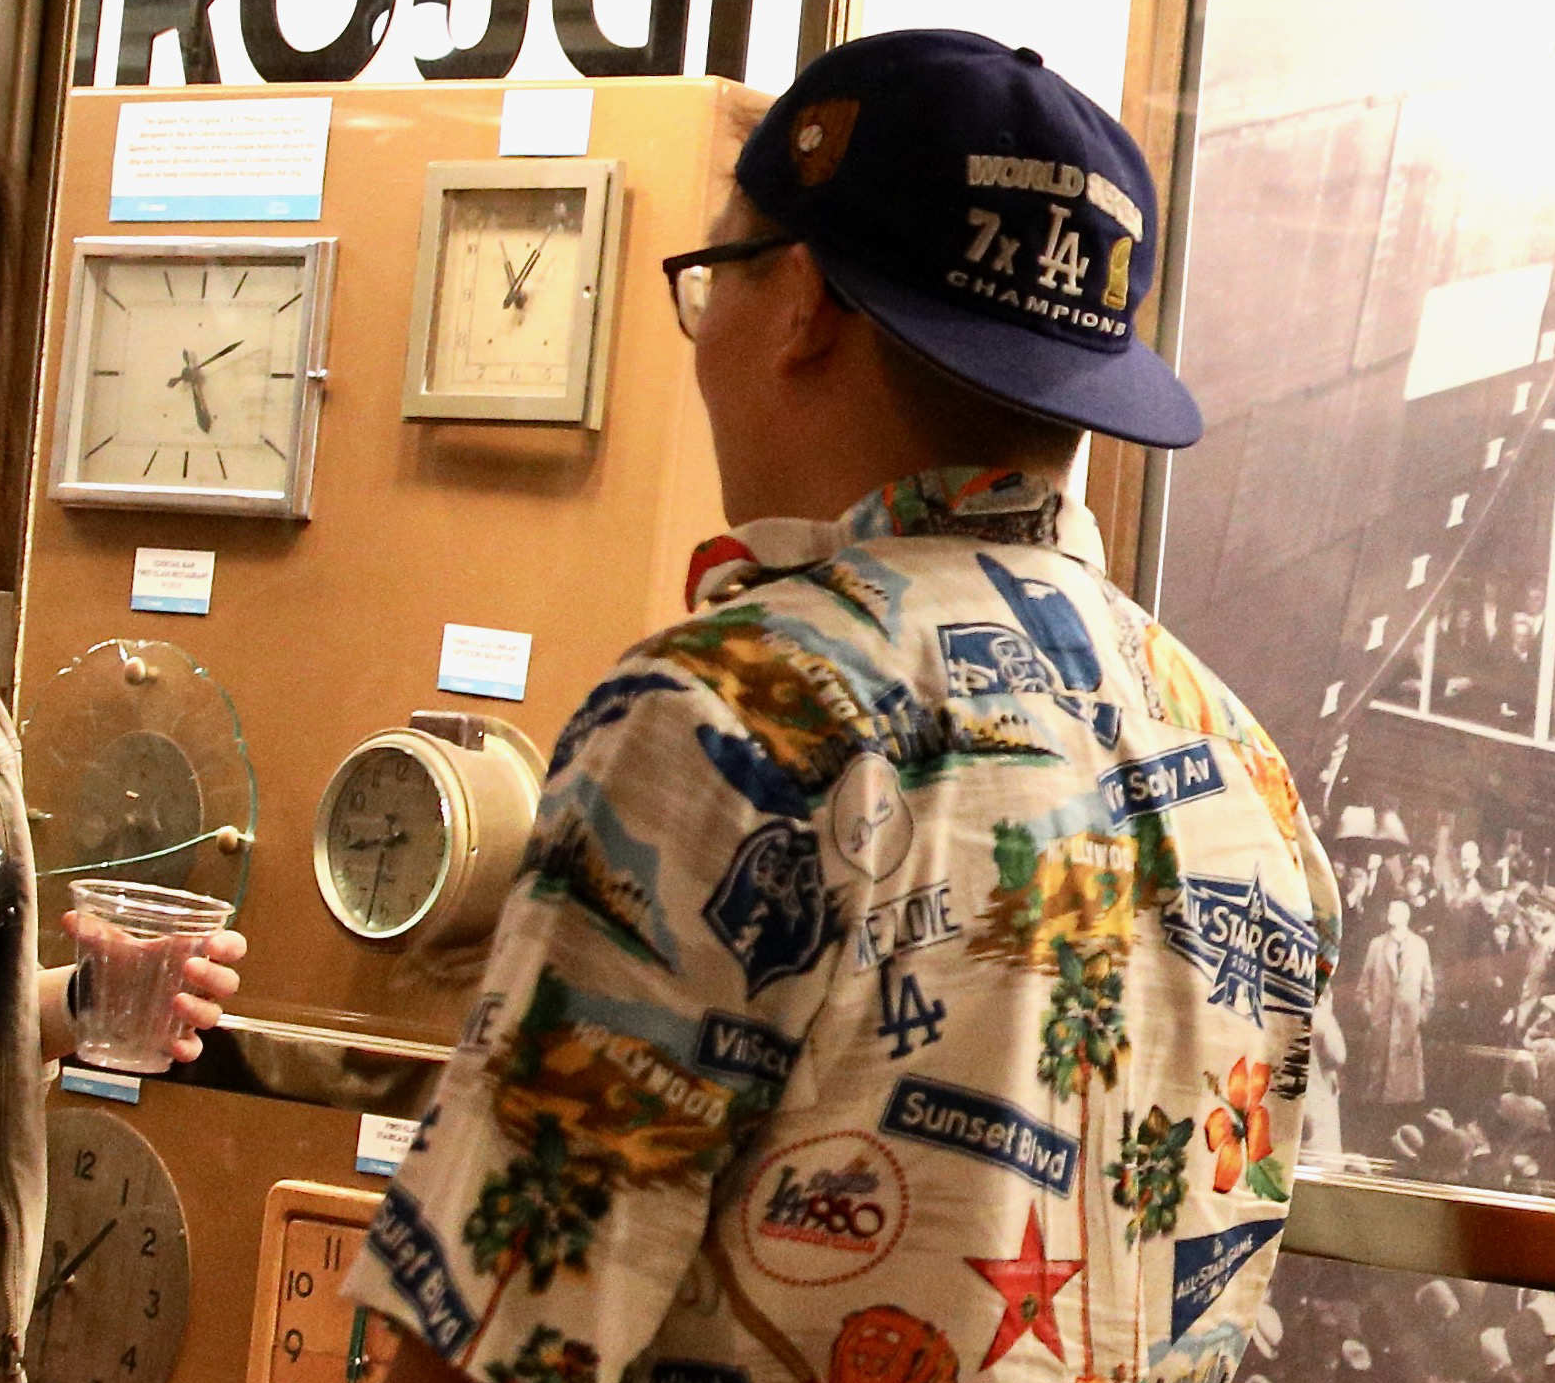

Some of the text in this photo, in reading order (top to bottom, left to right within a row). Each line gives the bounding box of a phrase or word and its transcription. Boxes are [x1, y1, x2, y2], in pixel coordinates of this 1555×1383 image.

[1037, 204, 1090, 296] LA
[946, 269, 1127, 338] CHAMPIONS
[877, 955, 946, 1061] LA
[901, 1091, 1068, 1181] Sunset Blvd
[75, 1149, 97, 1180] 12
[141, 1226, 157, 1257] 2
[323, 1234, 342, 1272] 11
[285, 1268, 313, 1301] 10
[142, 1288, 160, 1320] 3
[119, 1344, 137, 1375] 4
[283, 1327, 303, 1362] 9
